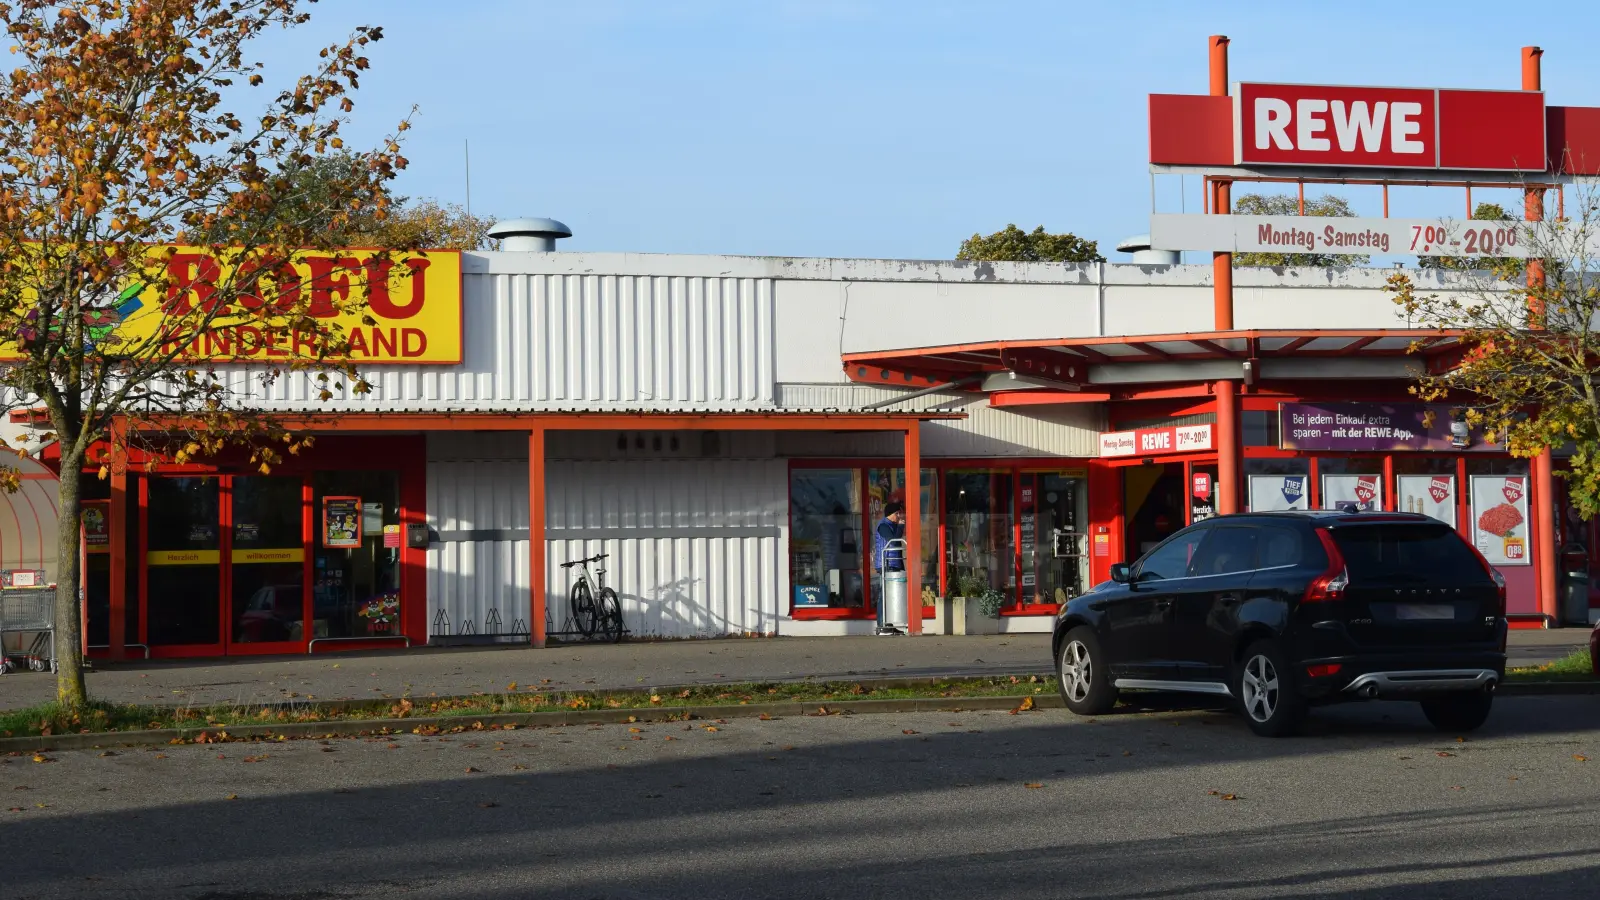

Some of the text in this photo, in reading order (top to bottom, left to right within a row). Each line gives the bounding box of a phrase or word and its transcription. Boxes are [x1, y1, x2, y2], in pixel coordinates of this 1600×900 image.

[1254, 97, 1425, 154] REWE
[1258, 223, 1389, 252] Montag-Samstag
[160, 253, 431, 320] ROFU
[160, 324, 428, 358] KINDERLAND
[1293, 413, 1390, 427] Bei jedem Einkauf extra
[1142, 432, 1170, 451] REWE
[1293, 429, 1321, 439] sparen
[1332, 427, 1347, 438] mit
[1348, 427, 1363, 438] der
[1364, 428, 1391, 438] REWE
[1393, 428, 1414, 441] App.
[1286, 479, 1301, 489] TIEF
[167, 551, 291, 561] Herzlich willkommen
[1507, 545, 1522, 558] 0.88
